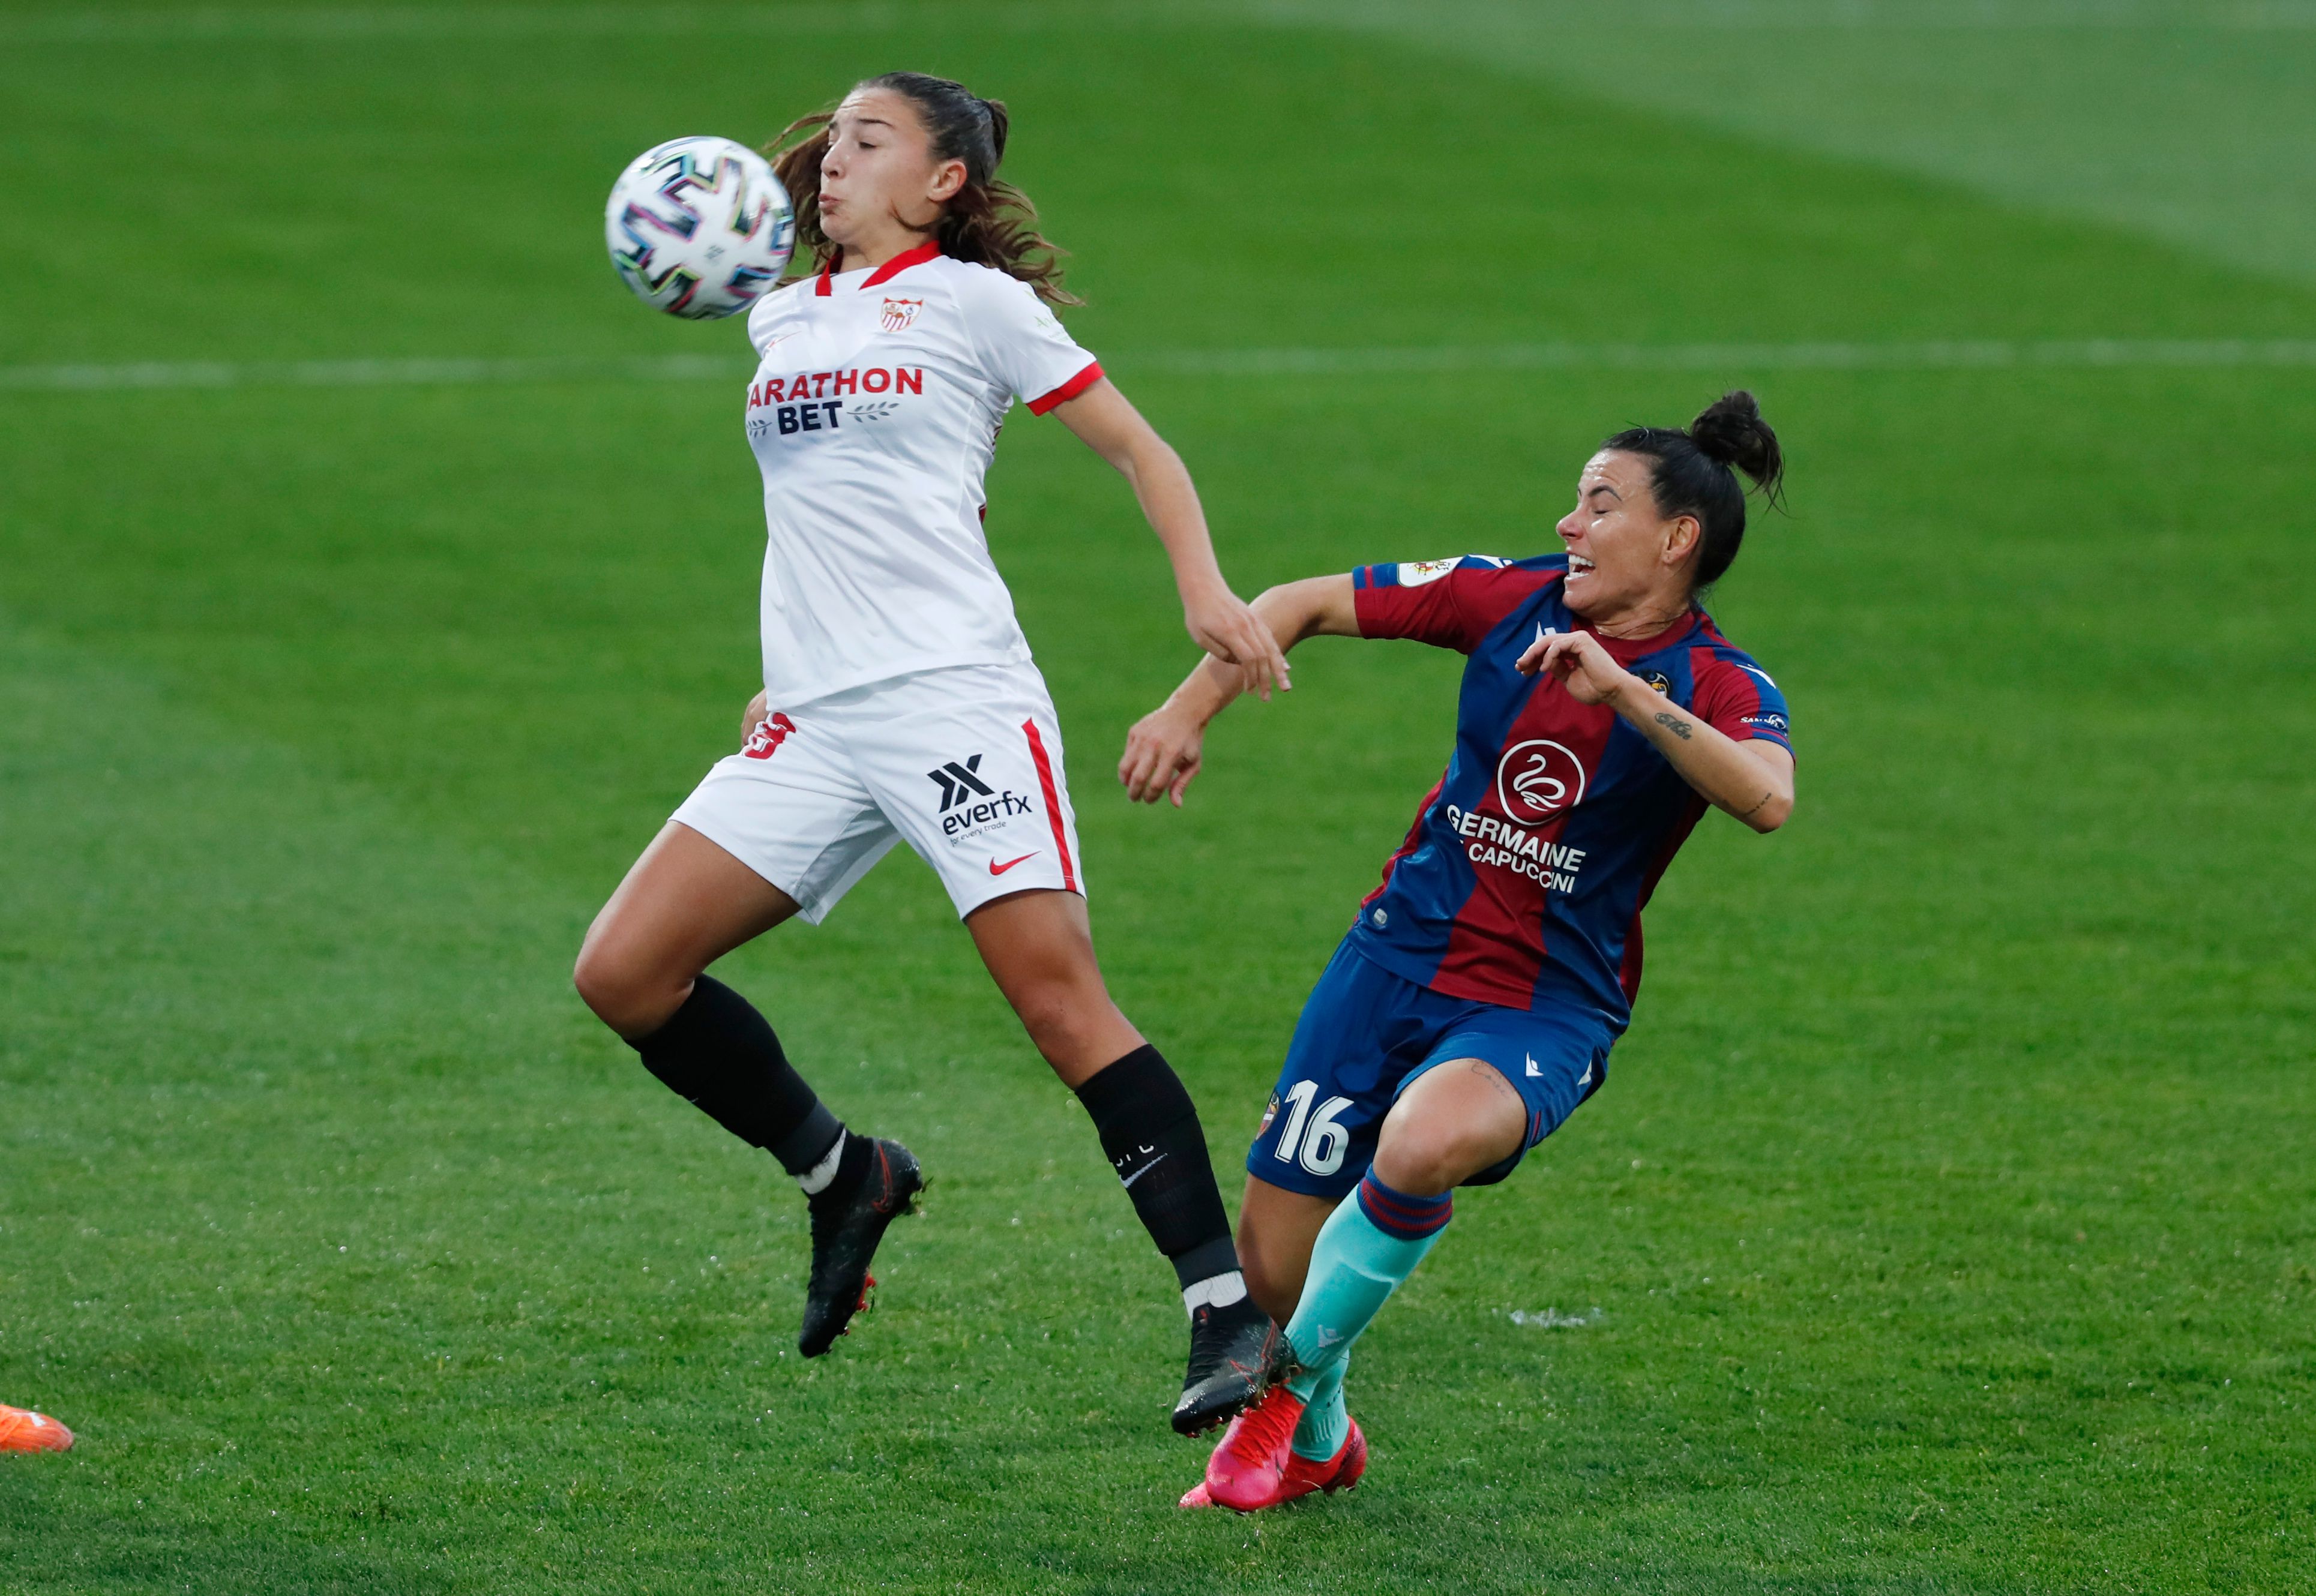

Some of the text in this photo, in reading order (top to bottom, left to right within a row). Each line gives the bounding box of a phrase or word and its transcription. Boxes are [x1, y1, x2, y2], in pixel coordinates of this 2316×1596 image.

[748, 368, 922, 412] ARATHON
[777, 401, 843, 434] BET
[943, 791, 1032, 835] everfx
[961, 827, 982, 839] every
[984, 821, 1006, 831] trade
[1447, 805, 1586, 872] GERMAINE
[1274, 1079, 1355, 1176] 16
